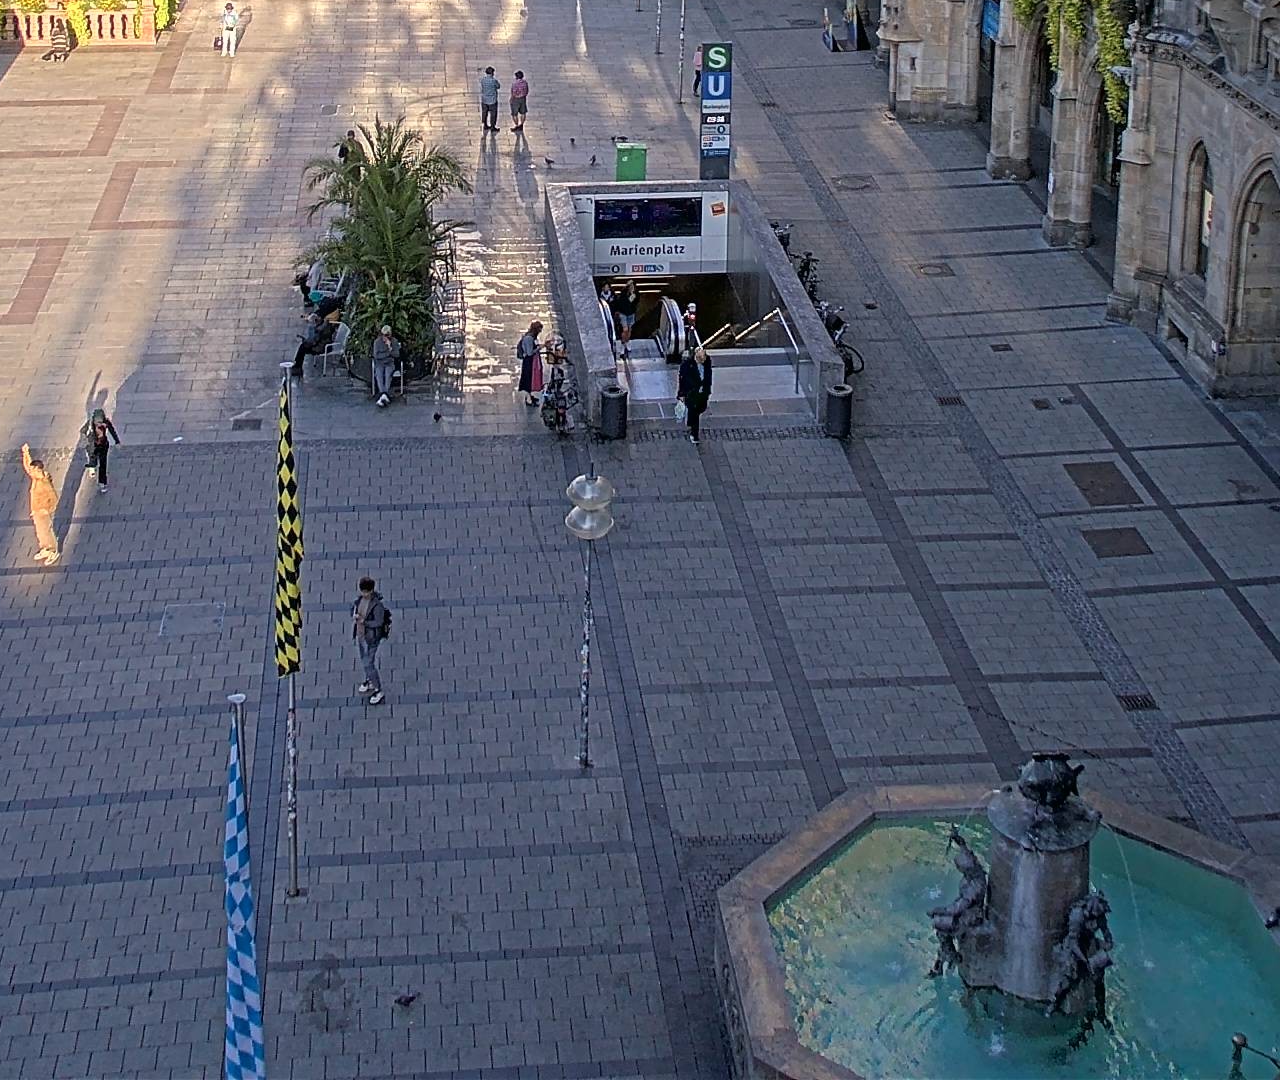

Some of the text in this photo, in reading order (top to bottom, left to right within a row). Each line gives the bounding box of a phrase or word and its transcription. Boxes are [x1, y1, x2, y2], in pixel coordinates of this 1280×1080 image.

[708, 46, 727, 69] S
[707, 75, 725, 97] U
[609, 243, 686, 258] Marienplatz
